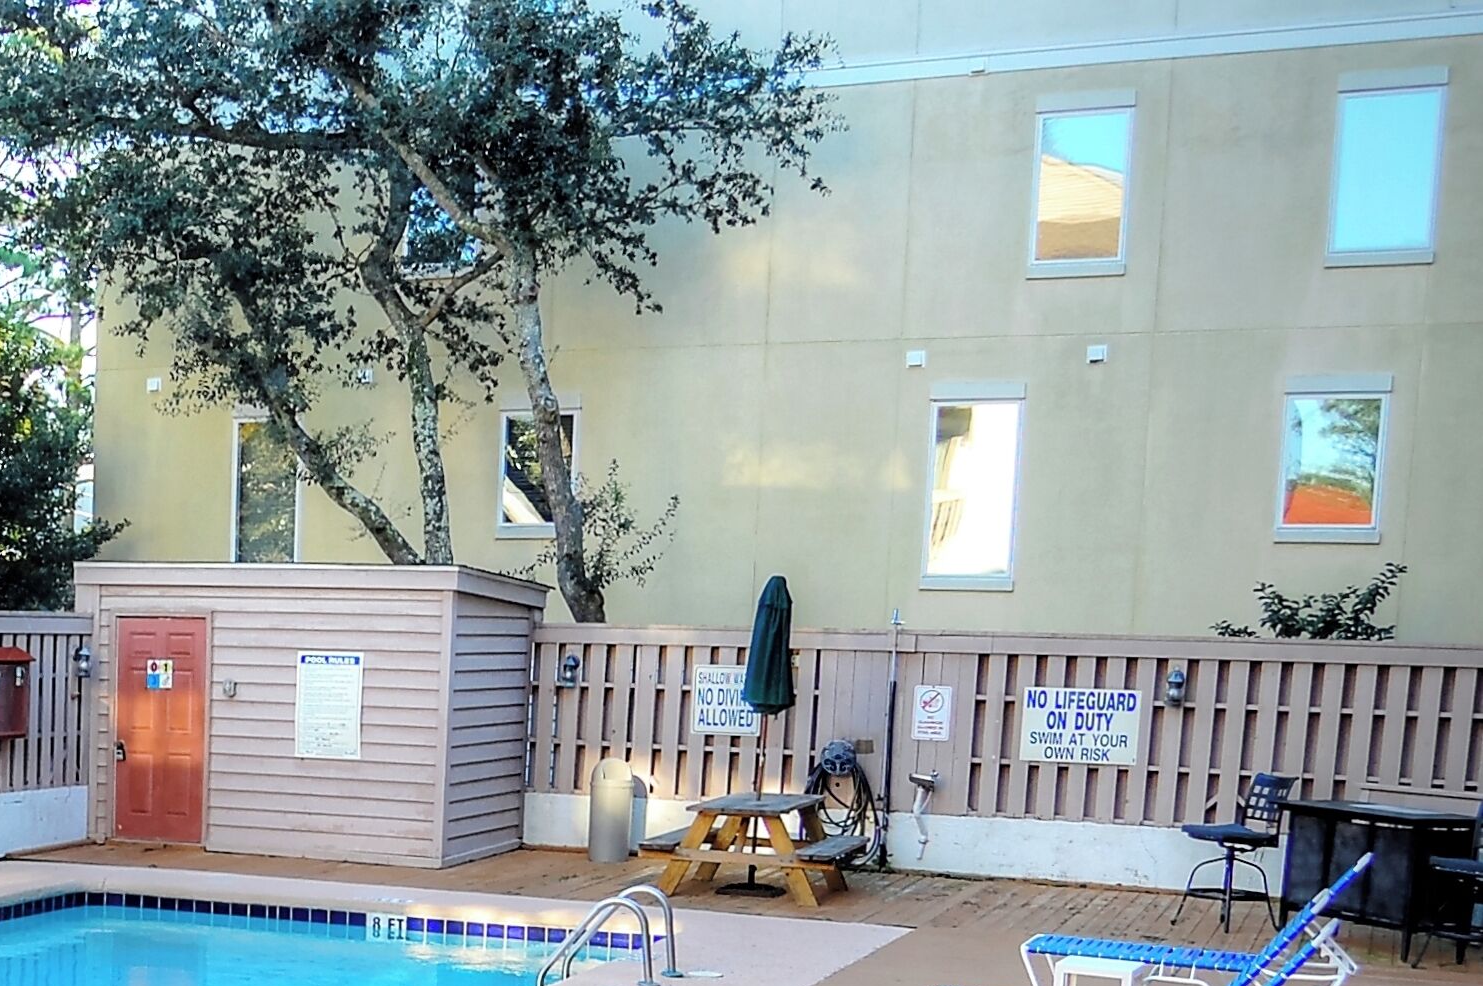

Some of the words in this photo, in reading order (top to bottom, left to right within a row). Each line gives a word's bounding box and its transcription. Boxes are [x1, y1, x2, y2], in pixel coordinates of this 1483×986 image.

[698, 688, 713, 706] NO
[1027, 690, 1047, 708] NO
[1055, 691, 1137, 711] LIFEGUARD
[698, 708, 754, 727] ALLOWED
[1047, 711, 1067, 730] ON
[1075, 712, 1113, 731] DUTY
[1030, 731, 1063, 744] SWIM
[1069, 733, 1086, 746] AT
[1093, 734, 1128, 747] YOUR
[1044, 746, 1074, 760] OWN
[1081, 747, 1110, 762] RISK
